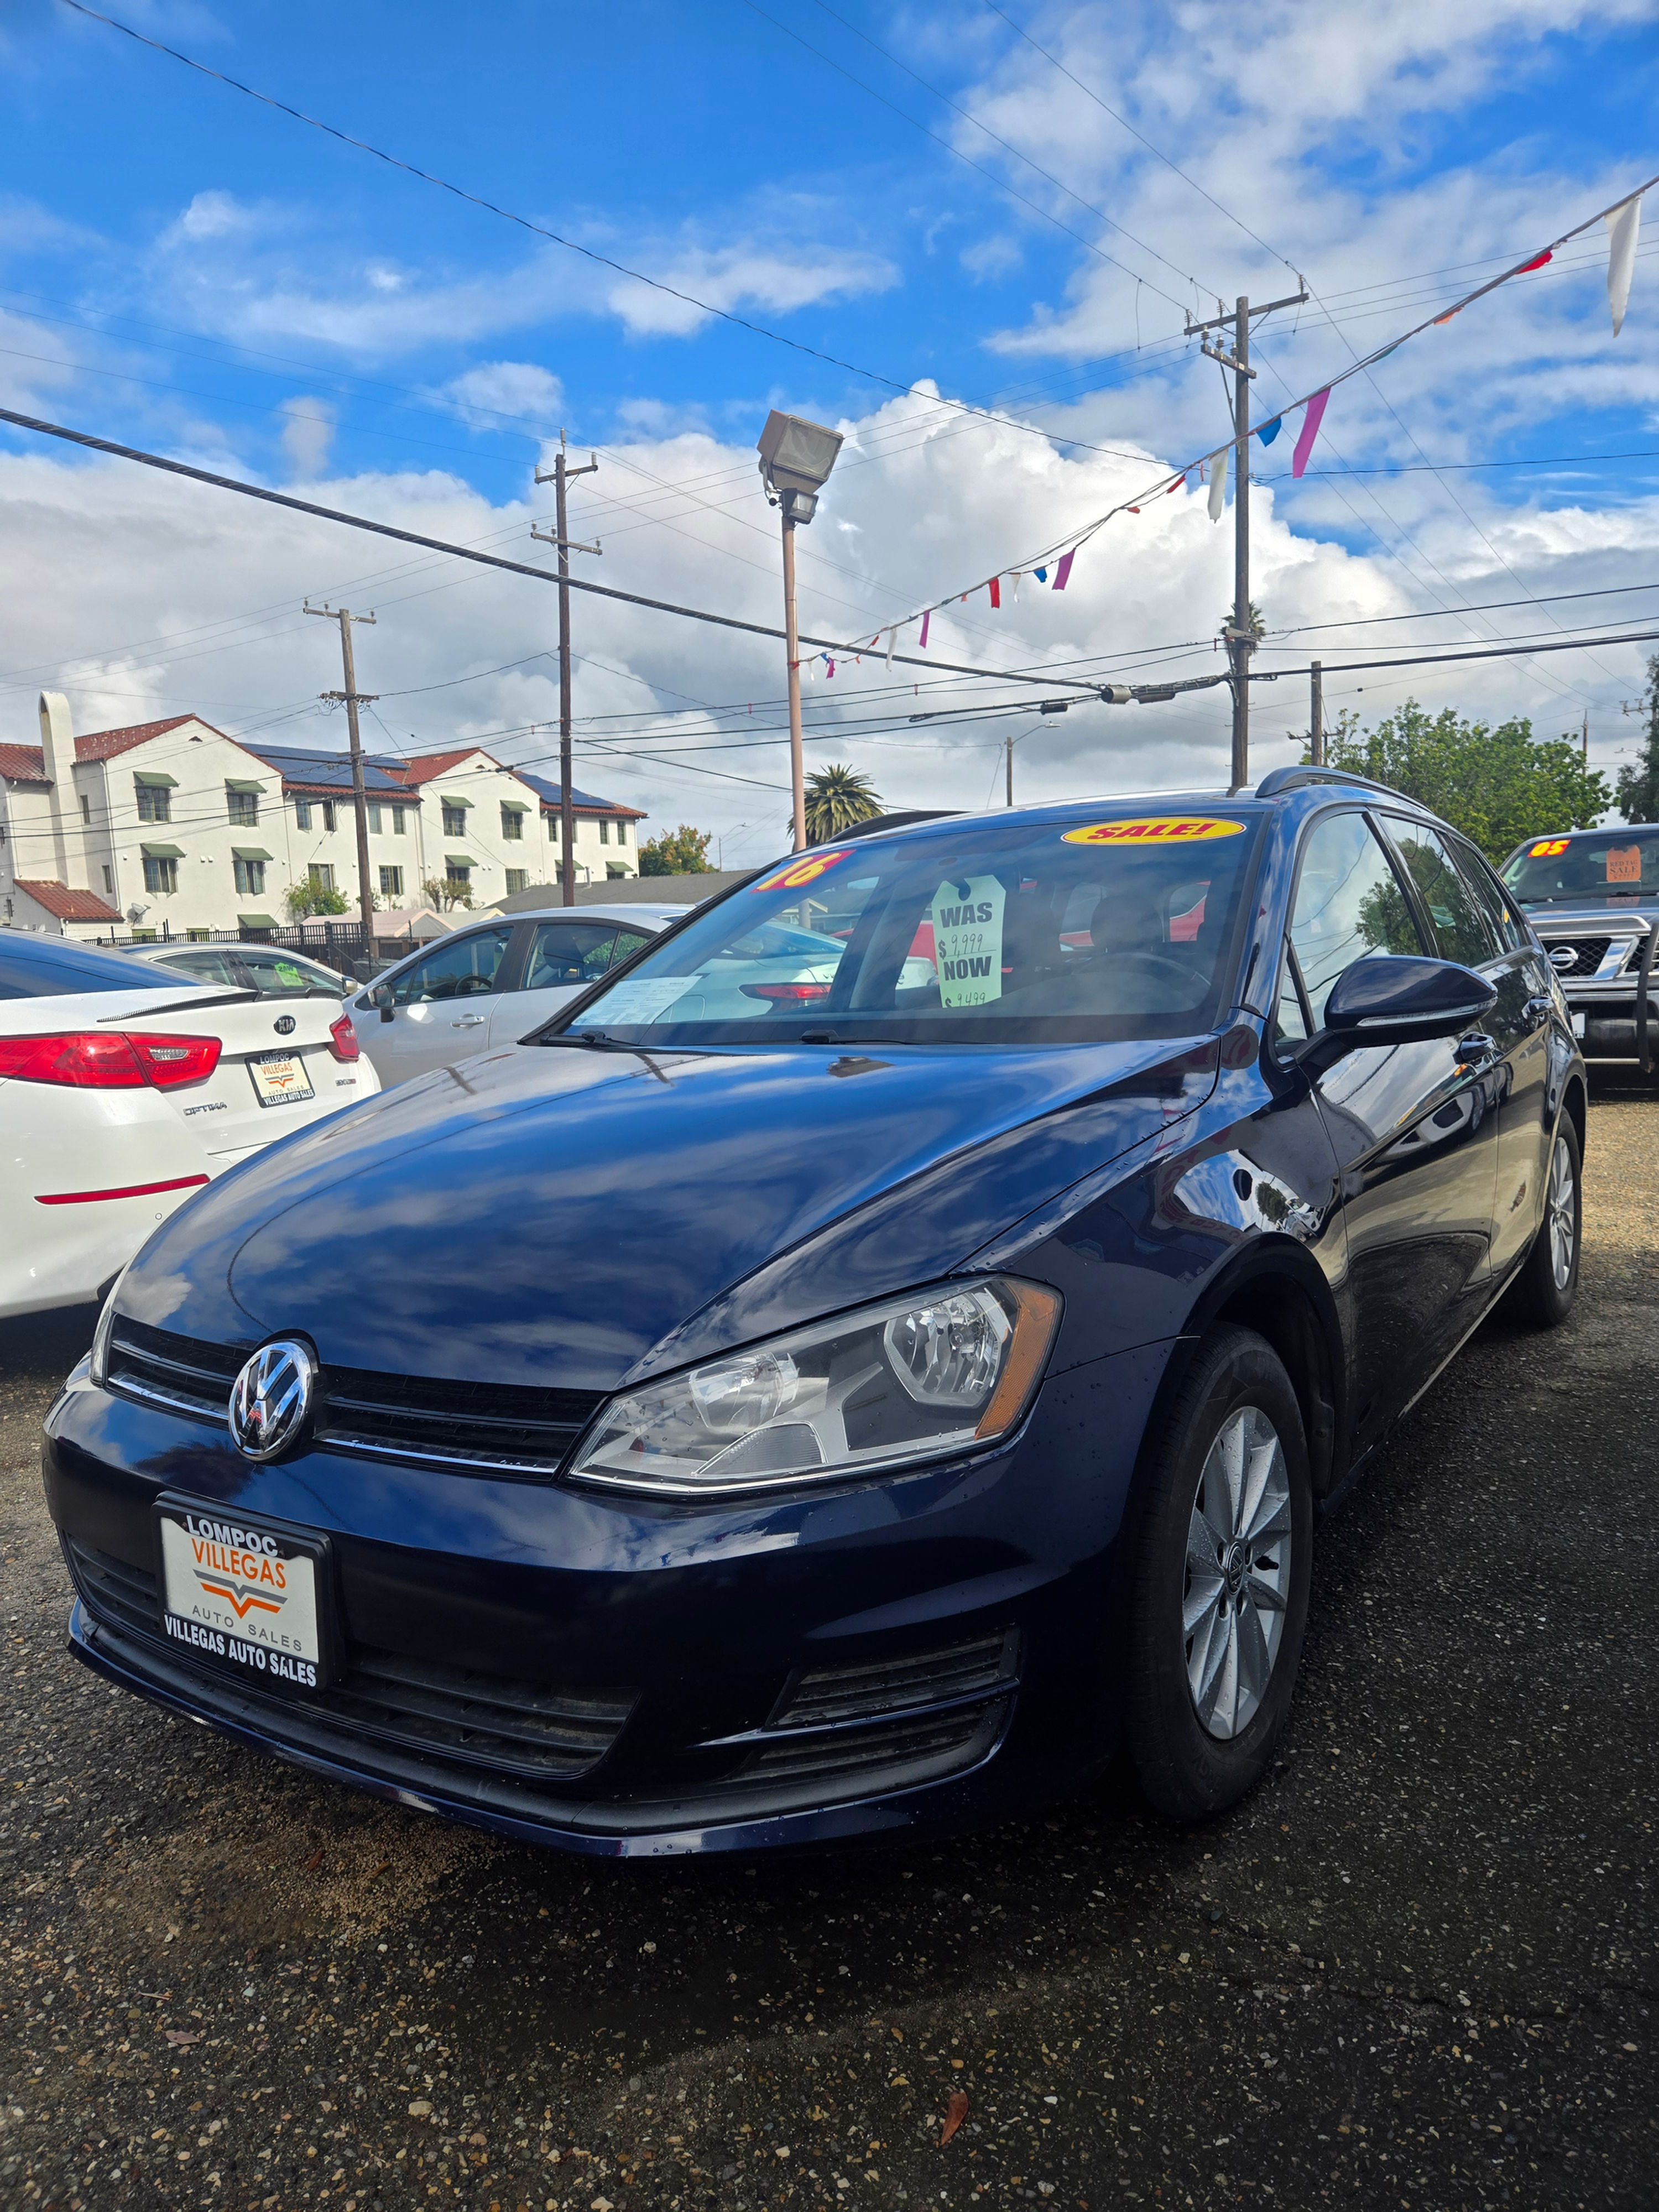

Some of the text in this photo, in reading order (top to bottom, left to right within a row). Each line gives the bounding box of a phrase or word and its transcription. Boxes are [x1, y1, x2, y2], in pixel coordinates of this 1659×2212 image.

[1087, 823, 1217, 839] SALE!
[1531, 839, 1569, 857] 05
[756, 853, 842, 891] 16
[1609, 865, 1637, 874] SALE
[940, 902, 993, 928] WAS
[938, 940, 947, 959] $
[943, 956, 992, 981] NOW
[278, 1019, 294, 1032] KIA
[259, 1053, 289, 1064] LOMPOC
[260, 1062, 293, 1076] VILLEGAS
[263, 1089, 314, 1105] VILLEGAS AUTO SALES
[183, 1102, 227, 1116] OPTIMA
[186, 1515, 278, 1557] LOMPOC
[191, 1538, 286, 1589] VILLEGAS
[192, 1605, 302, 1651] AUTO SALES
[164, 1614, 317, 1687] VILLEGAS AUTO SALES
